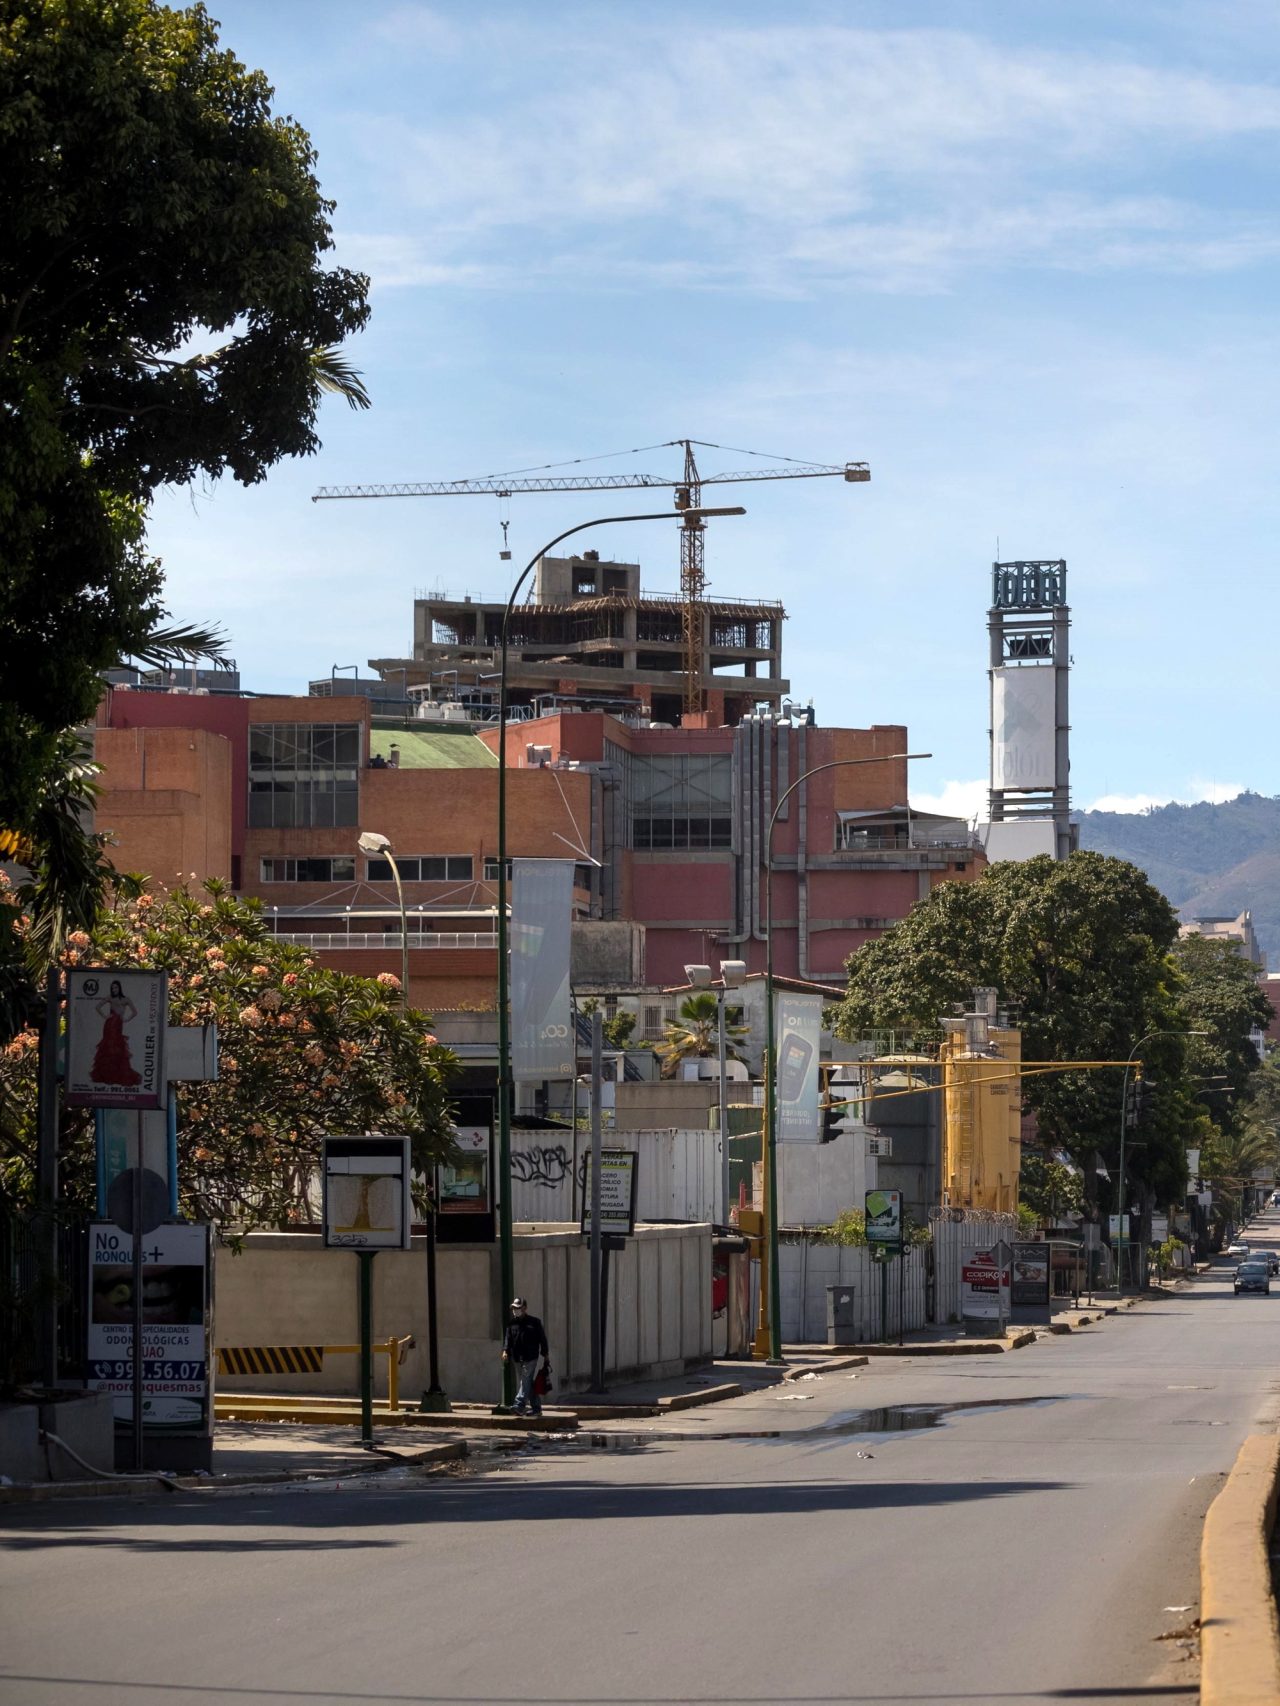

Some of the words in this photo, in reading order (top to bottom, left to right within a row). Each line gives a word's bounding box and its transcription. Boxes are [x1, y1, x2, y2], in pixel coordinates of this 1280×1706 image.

[144, 1035, 156, 1091] ALQUILER
[96, 1233, 119, 1250] No
[95, 1251, 147, 1263] RONQUS
[106, 1335, 189, 1345] ODONOLÓGICAS
[126, 1346, 165, 1358] CUAO
